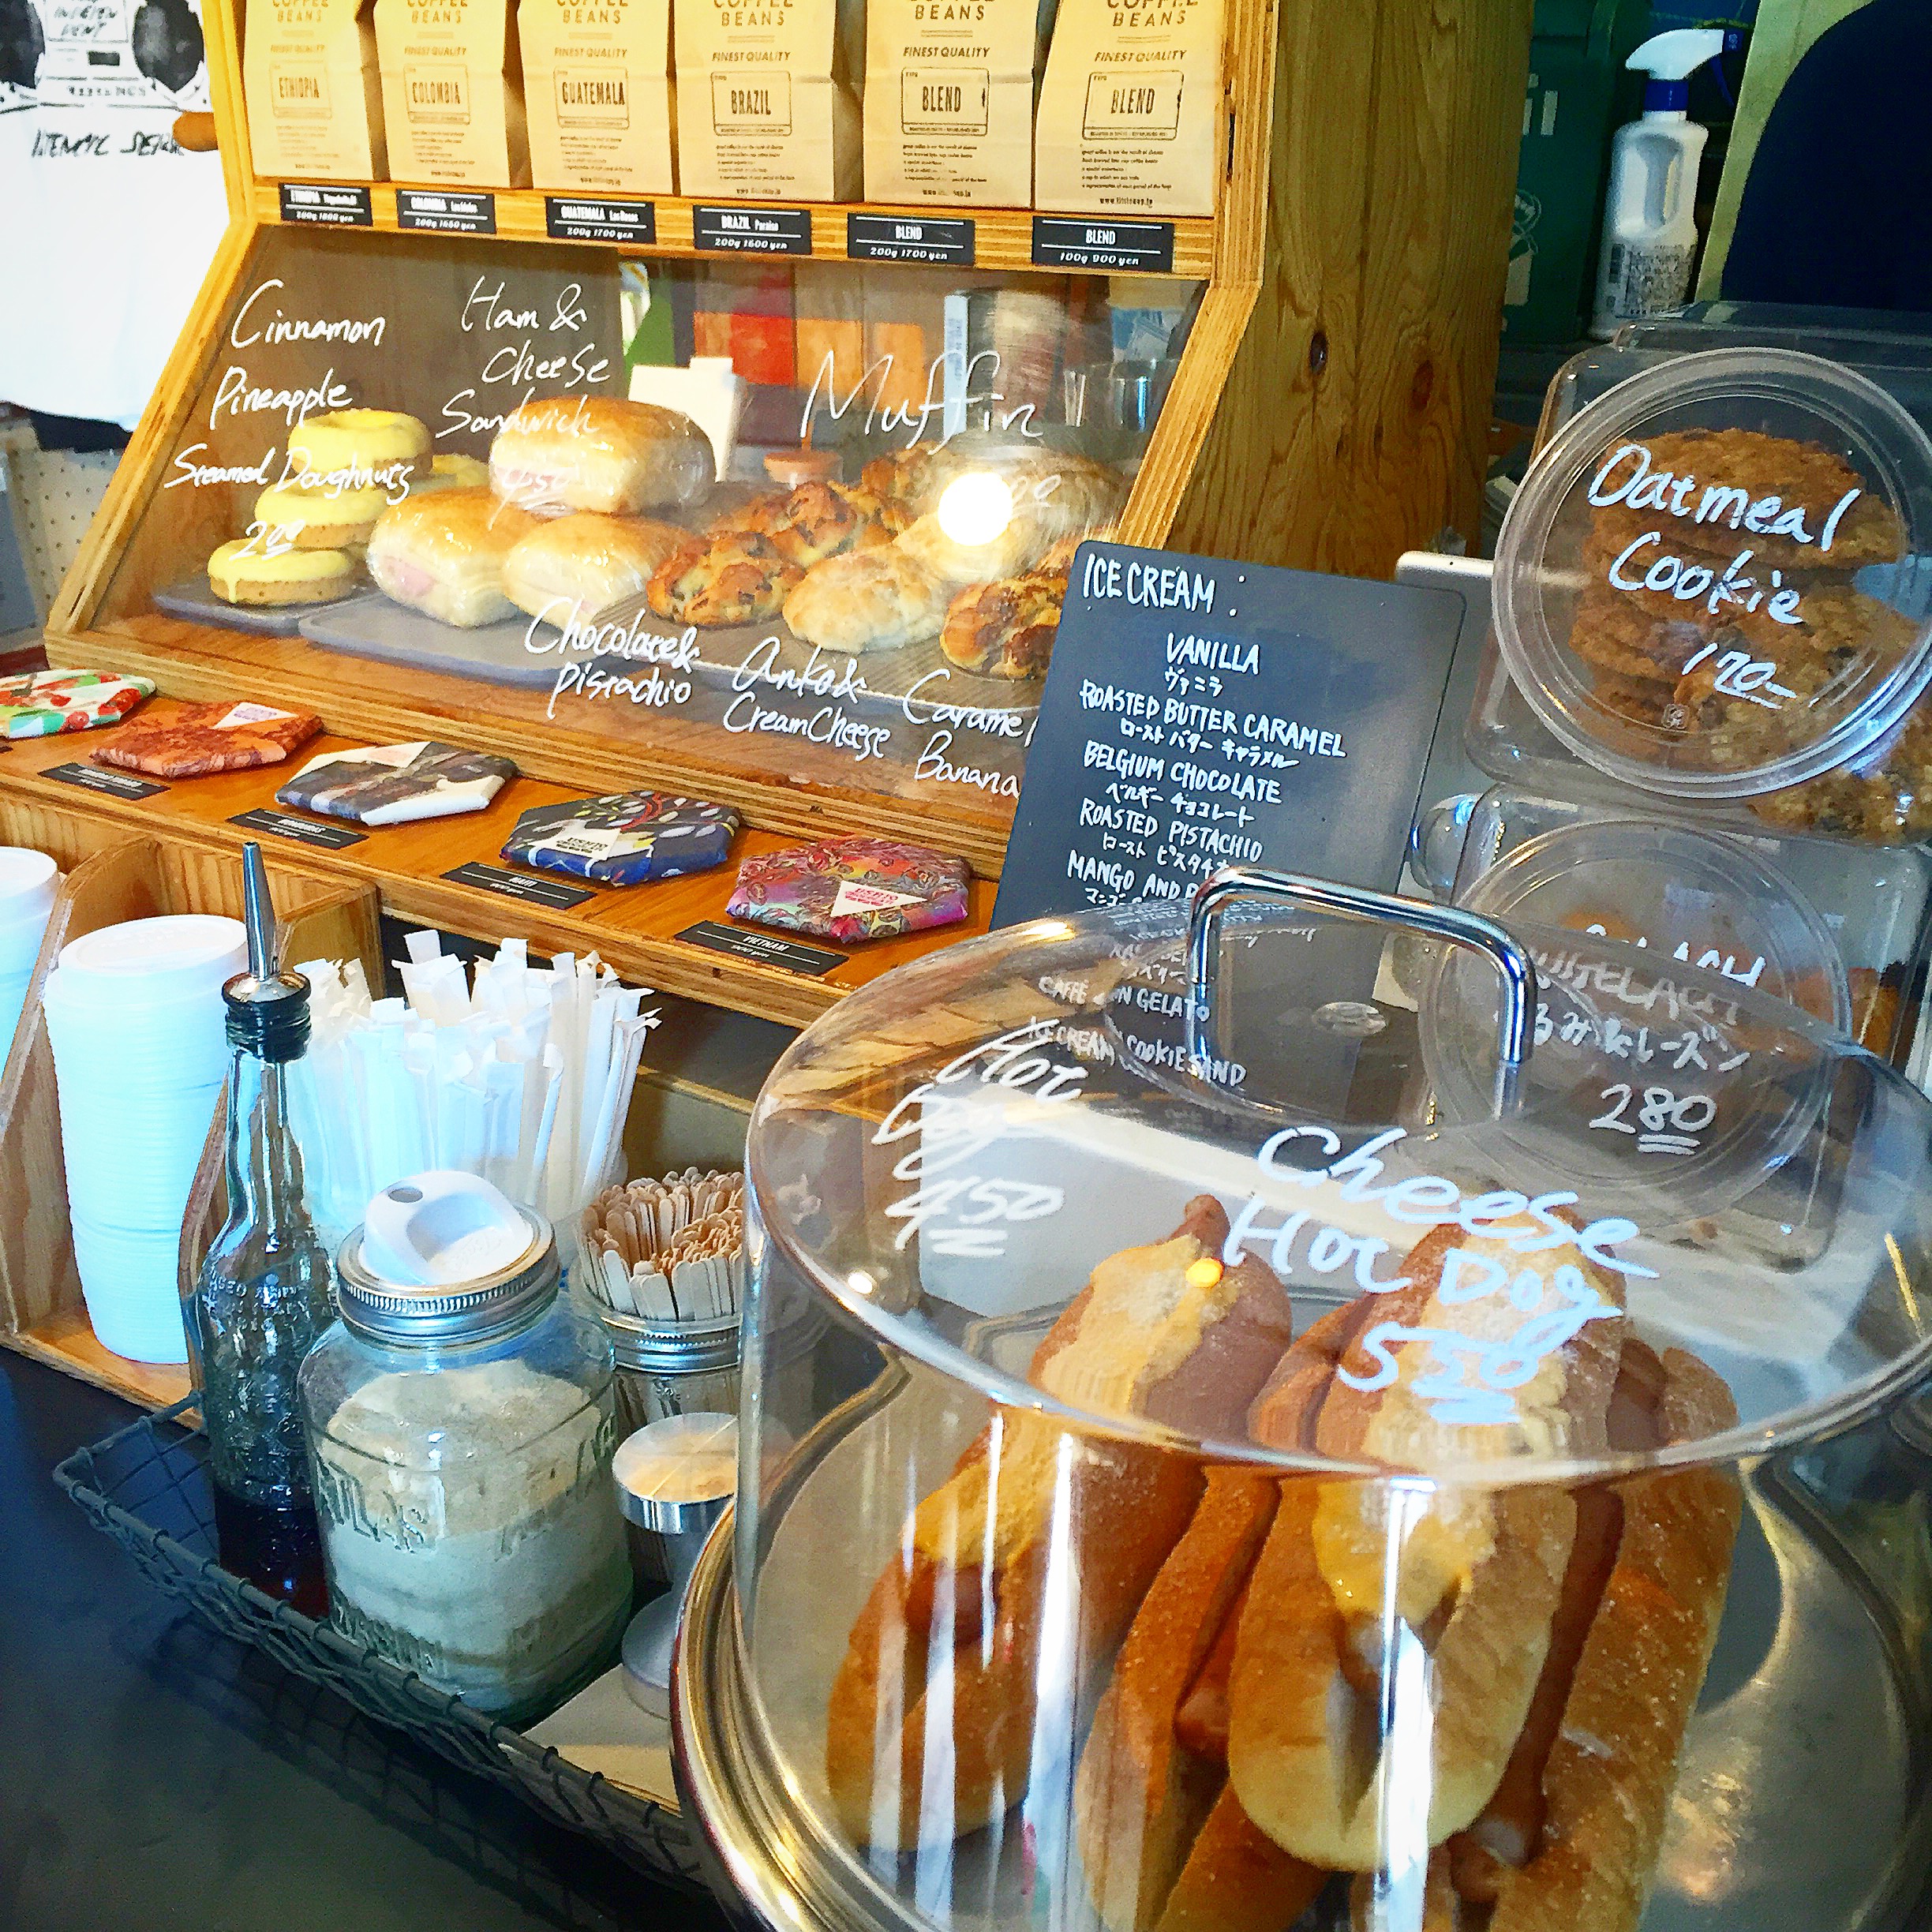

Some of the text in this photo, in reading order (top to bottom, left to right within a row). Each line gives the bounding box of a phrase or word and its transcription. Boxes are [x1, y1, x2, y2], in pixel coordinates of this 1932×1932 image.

[277, 9, 322, 23] BEANS
[411, 9, 462, 24] BEANS
[563, 9, 621, 24] BEANS
[721, 10, 784, 26] BEANS
[915, 5, 985, 20] BEANS
[1113, 9, 1186, 27] BEANS
[554, 47, 627, 58] FINEST QUALITY
[712, 51, 791, 62] FINEST QUALITY
[903, 47, 990, 58] FINEST QUALITY
[1094, 50, 1187, 62] FINEST QUALITY
[279, 77, 320, 99] ETHIOPIA
[412, 81, 460, 104] COLOMBIA
[562, 81, 625, 106] GUATEMALA
[731, 89, 771, 115] BRAZIL
[922, 86, 961, 112] BLEND
[1110, 88, 1155, 114] BLEND
[560, 205, 606, 221] GUATEMALA
[721, 215, 751, 230] BRAZIL
[567, 227, 634, 240] 200g 1700 yen
[714, 238, 788, 251] 200g 1600 yen
[895, 225, 923, 241] BLEND
[1085, 229, 1116, 245] BLEND
[870, 247, 948, 261] 200g 1700 yen
[1060, 252, 1139, 267] 100g 900 yen
[230, 279, 386, 349] Cinnamon
[461, 275, 587, 331] Ham &
[481, 339, 611, 388] Cheese
[208, 365, 354, 431] Pineapple
[435, 386, 601, 440] Sandwich
[800, 349, 1044, 456] Muffin
[163, 443, 415, 506] Steamed Doughnuts
[1587, 444, 1863, 552] Oatmeal
[1083, 552, 1216, 615] ICE CREAM
[1607, 530, 1805, 625] Cookie
[1165, 631, 1260, 676] VANILLA
[1163, 665, 1224, 698] ヴァニラ
[901, 668, 1040, 748] Caramel
[1078, 678, 1347, 758] ROASTED BUTTER CARAMEL
[1119, 717, 1166, 746] ロースト
[1168, 729, 1215, 754] バター
[913, 729, 1022, 799] Banana
[1083, 739, 1284, 805] BELGIUM CHOCOLATE
[1104, 781, 1256, 829] ベルギー チョコレート
[1078, 796, 1264, 863] ROASTED PISTACHIO
[1102, 831, 1148, 859] ロースト
[1066, 848, 1136, 894] MANGO
[1142, 873, 1181, 900] AND
[743, 935, 791, 952] VIETNAM
[1136, 987, 1211, 1022] GELATO
[935, 1018, 1089, 1103] Hot
[1126, 1034, 1187, 1073] COOKIE
[1187, 1053, 1248, 1087] SAND
[1589, 1083, 1718, 1134] 280
[884, 1175, 1065, 1251] 450
[1257, 1125, 1661, 1279] Cheese
[1222, 1195, 1625, 1357] Hot Dog
